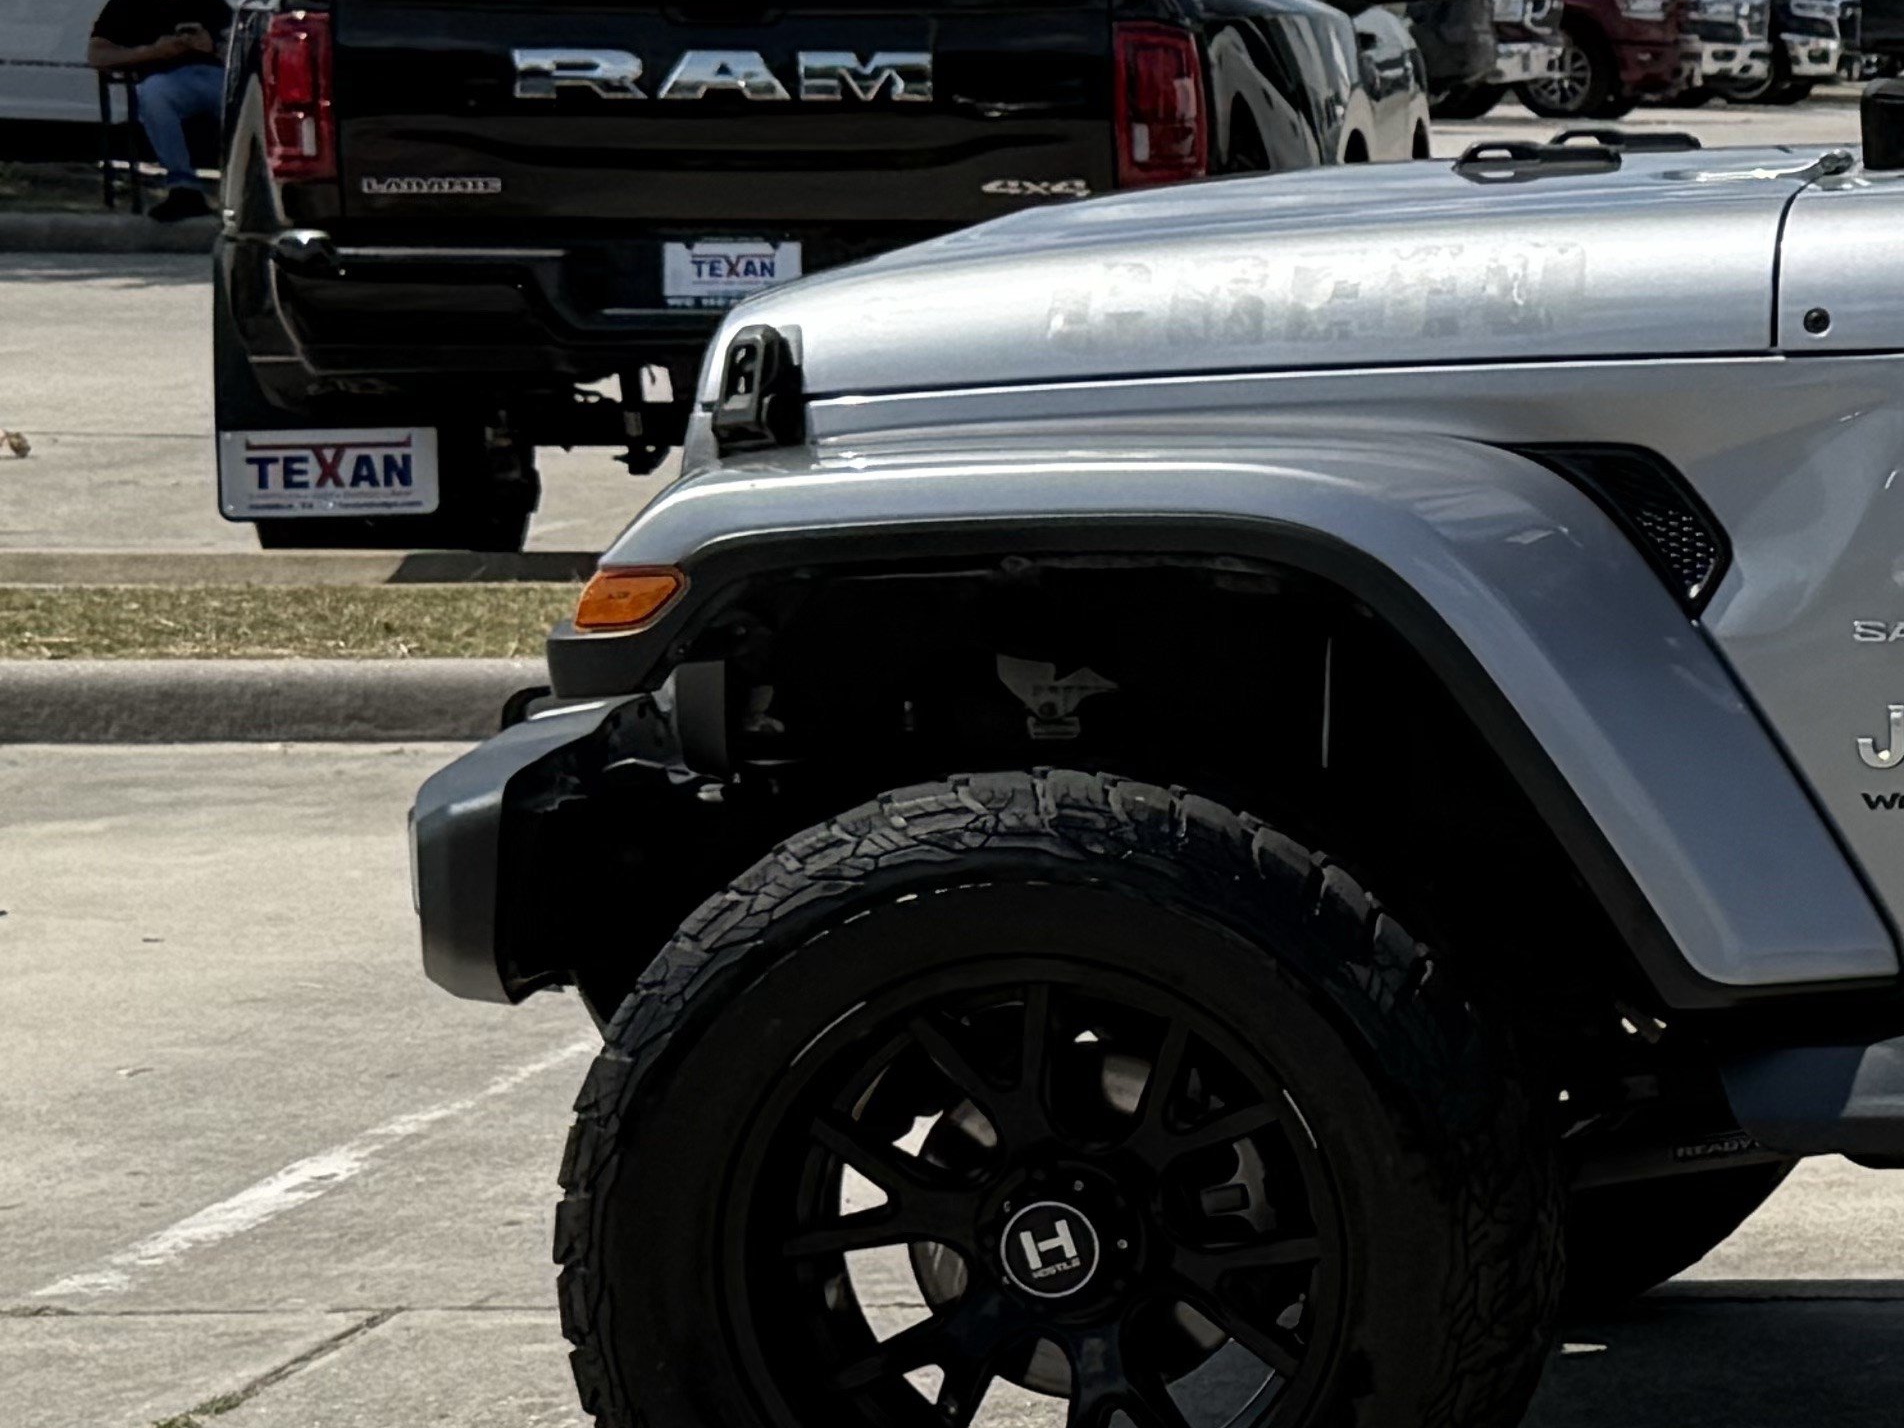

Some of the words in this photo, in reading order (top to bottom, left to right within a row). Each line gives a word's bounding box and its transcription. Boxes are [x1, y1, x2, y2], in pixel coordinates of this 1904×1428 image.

[512, 48, 935, 101] RAM
[690, 254, 776, 279] TEXAN
[245, 445, 413, 490] TEXAN
